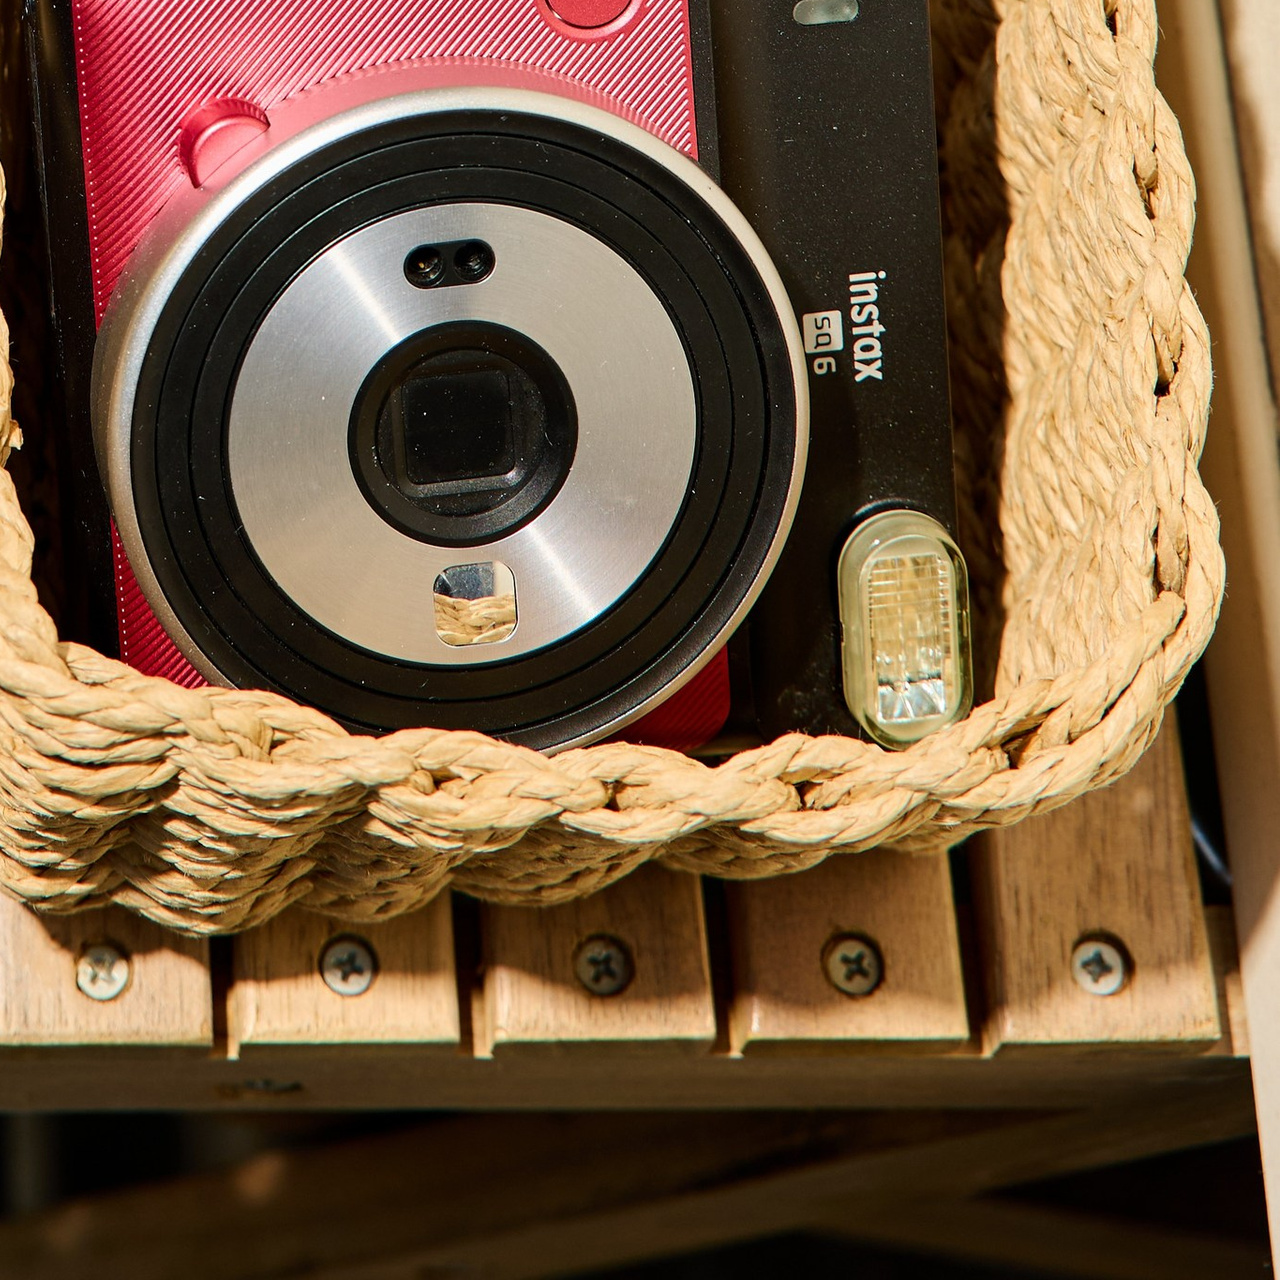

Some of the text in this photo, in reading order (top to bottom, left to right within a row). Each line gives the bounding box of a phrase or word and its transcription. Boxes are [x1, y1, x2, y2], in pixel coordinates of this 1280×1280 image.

[813, 316, 837, 375] SQ 6
[849, 269, 887, 383] instax
